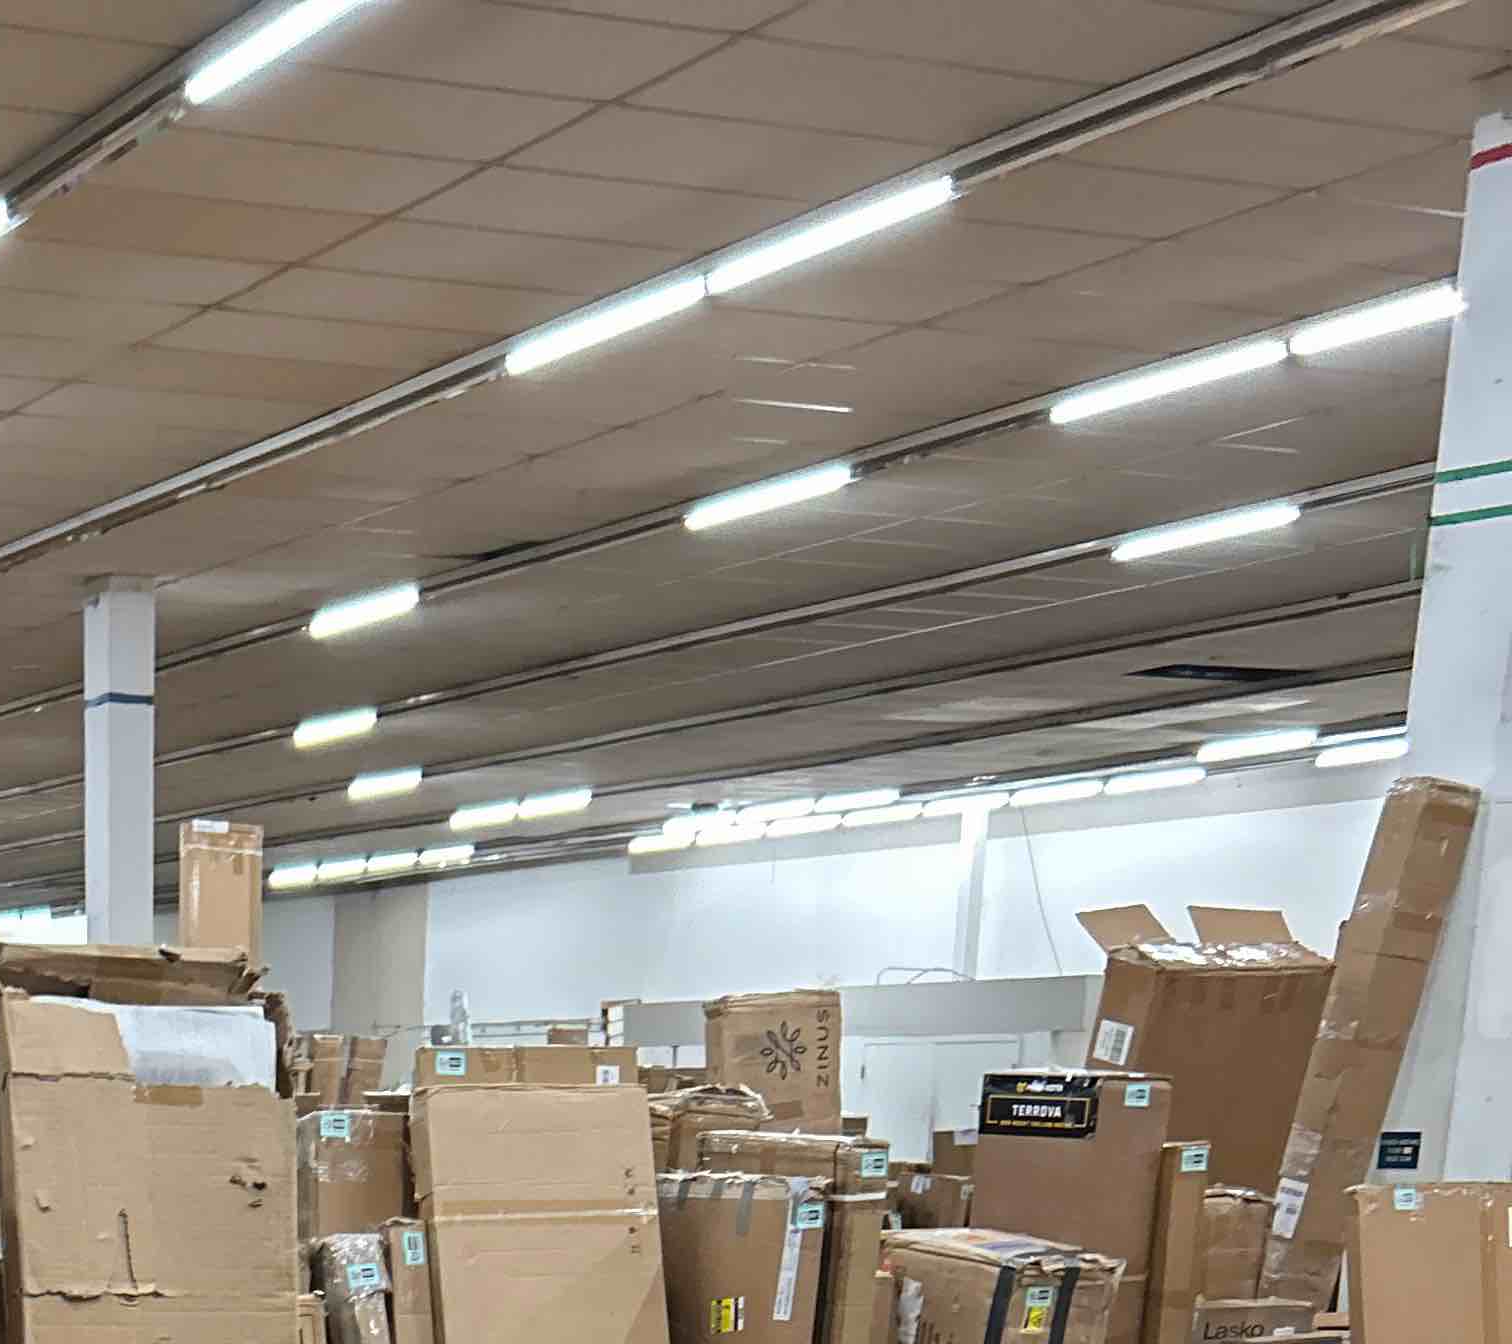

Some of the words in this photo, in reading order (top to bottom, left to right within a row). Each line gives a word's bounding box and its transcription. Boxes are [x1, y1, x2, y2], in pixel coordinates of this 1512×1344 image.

[816, 1007, 830, 1088] ZINUS
[1011, 1104, 1063, 1118] TERROVA
[1203, 1320, 1265, 1340] Lasko
